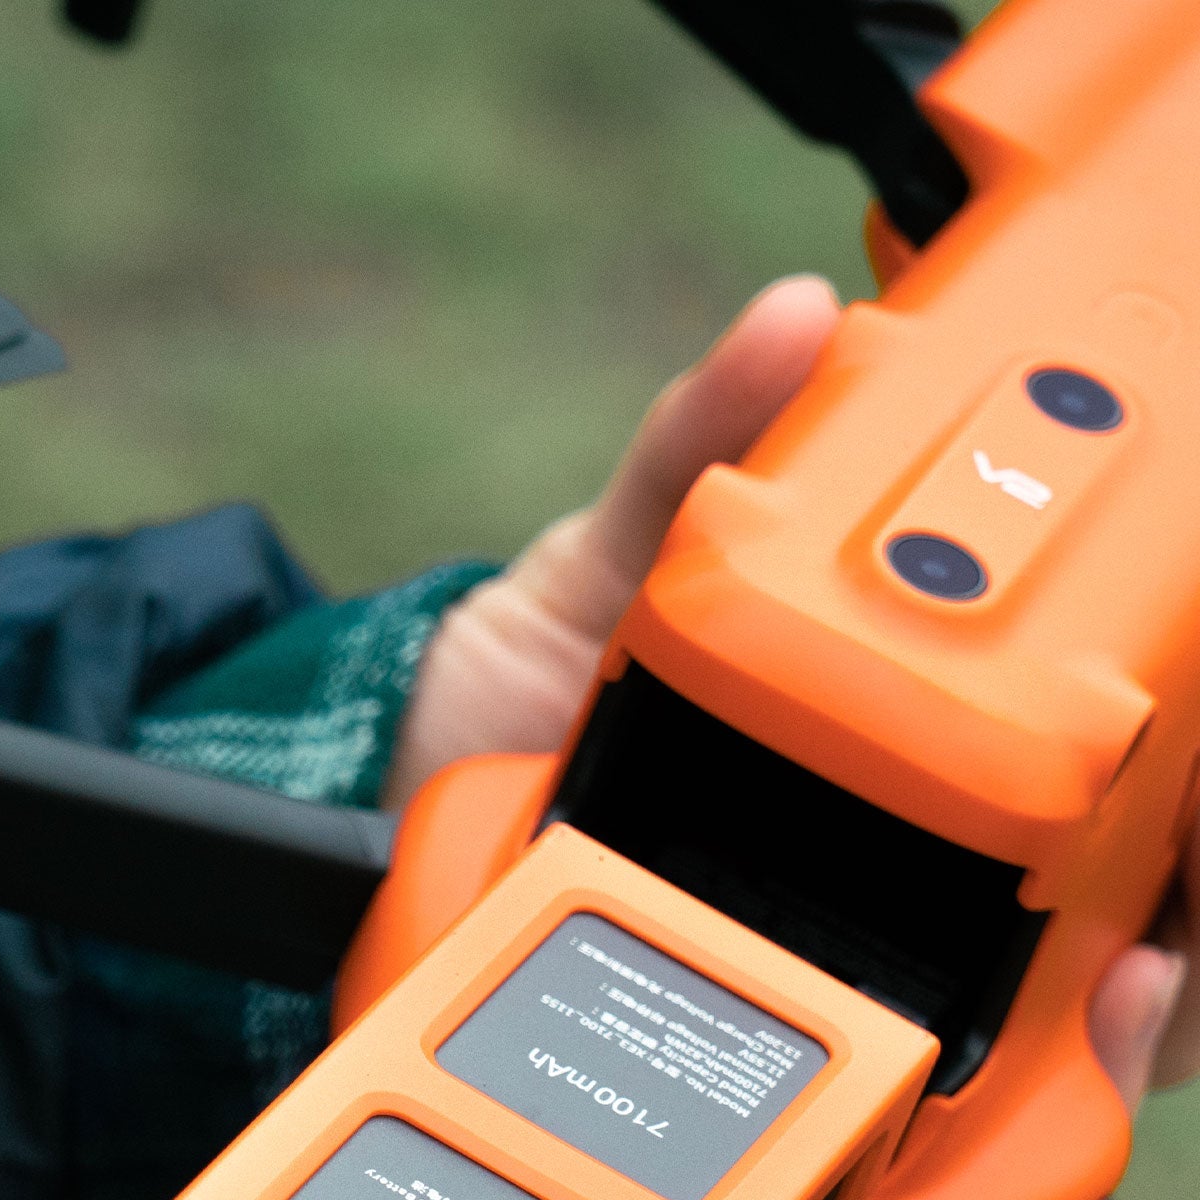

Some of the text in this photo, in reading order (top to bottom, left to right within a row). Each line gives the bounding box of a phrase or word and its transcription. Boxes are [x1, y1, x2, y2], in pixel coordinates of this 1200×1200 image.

[664, 992, 714, 1025] Voltage
[667, 1022, 717, 1055] Voltage
[716, 1021, 768, 1052] Charge
[659, 1043, 718, 1083] Capacity
[718, 1051, 777, 1088] Nominal
[766, 1049, 794, 1069] Max
[707, 1089, 750, 1117] Model
[718, 1080, 759, 1107] Rated
[365, 1169, 416, 1200] Battery
